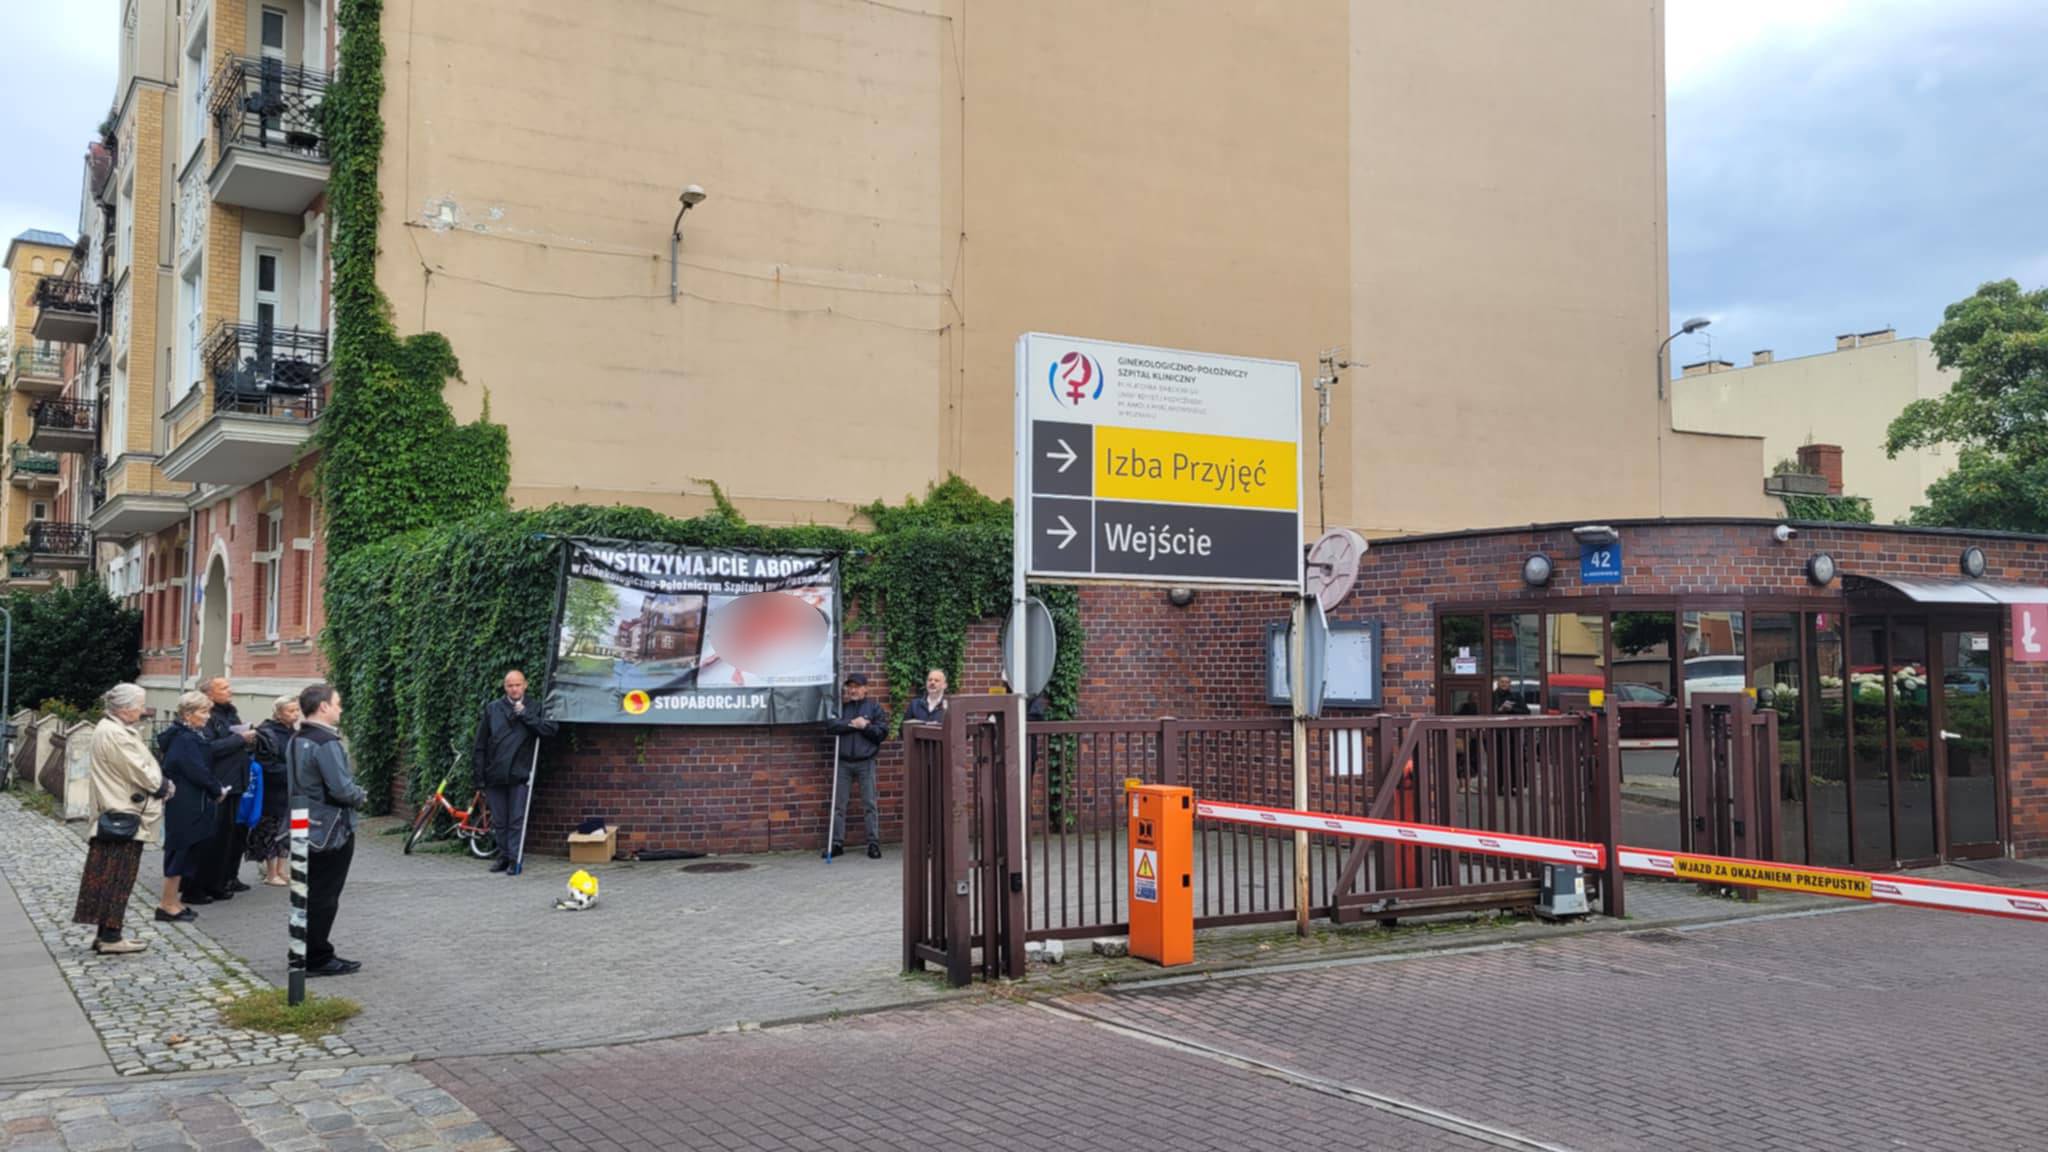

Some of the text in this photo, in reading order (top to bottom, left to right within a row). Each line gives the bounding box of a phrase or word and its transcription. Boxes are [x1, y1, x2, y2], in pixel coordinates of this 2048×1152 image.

[1117, 357, 1248, 378] GINEKOLOGICZNO-POŁOŻNICZY
[1117, 368, 1197, 384] SZPITAL KLINICZNY
[1106, 447, 1268, 493] Izba Przyjęć
[1104, 522, 1213, 561] Wejście
[573, 547, 749, 577] WSTRZYMAJCIE
[1591, 551, 1611, 568] 42
[654, 694, 767, 710] STOPABORCJI.PL
[1678, 860, 1866, 892] WJAZD ZA OKAZANIEM PRZEPUSTKI
